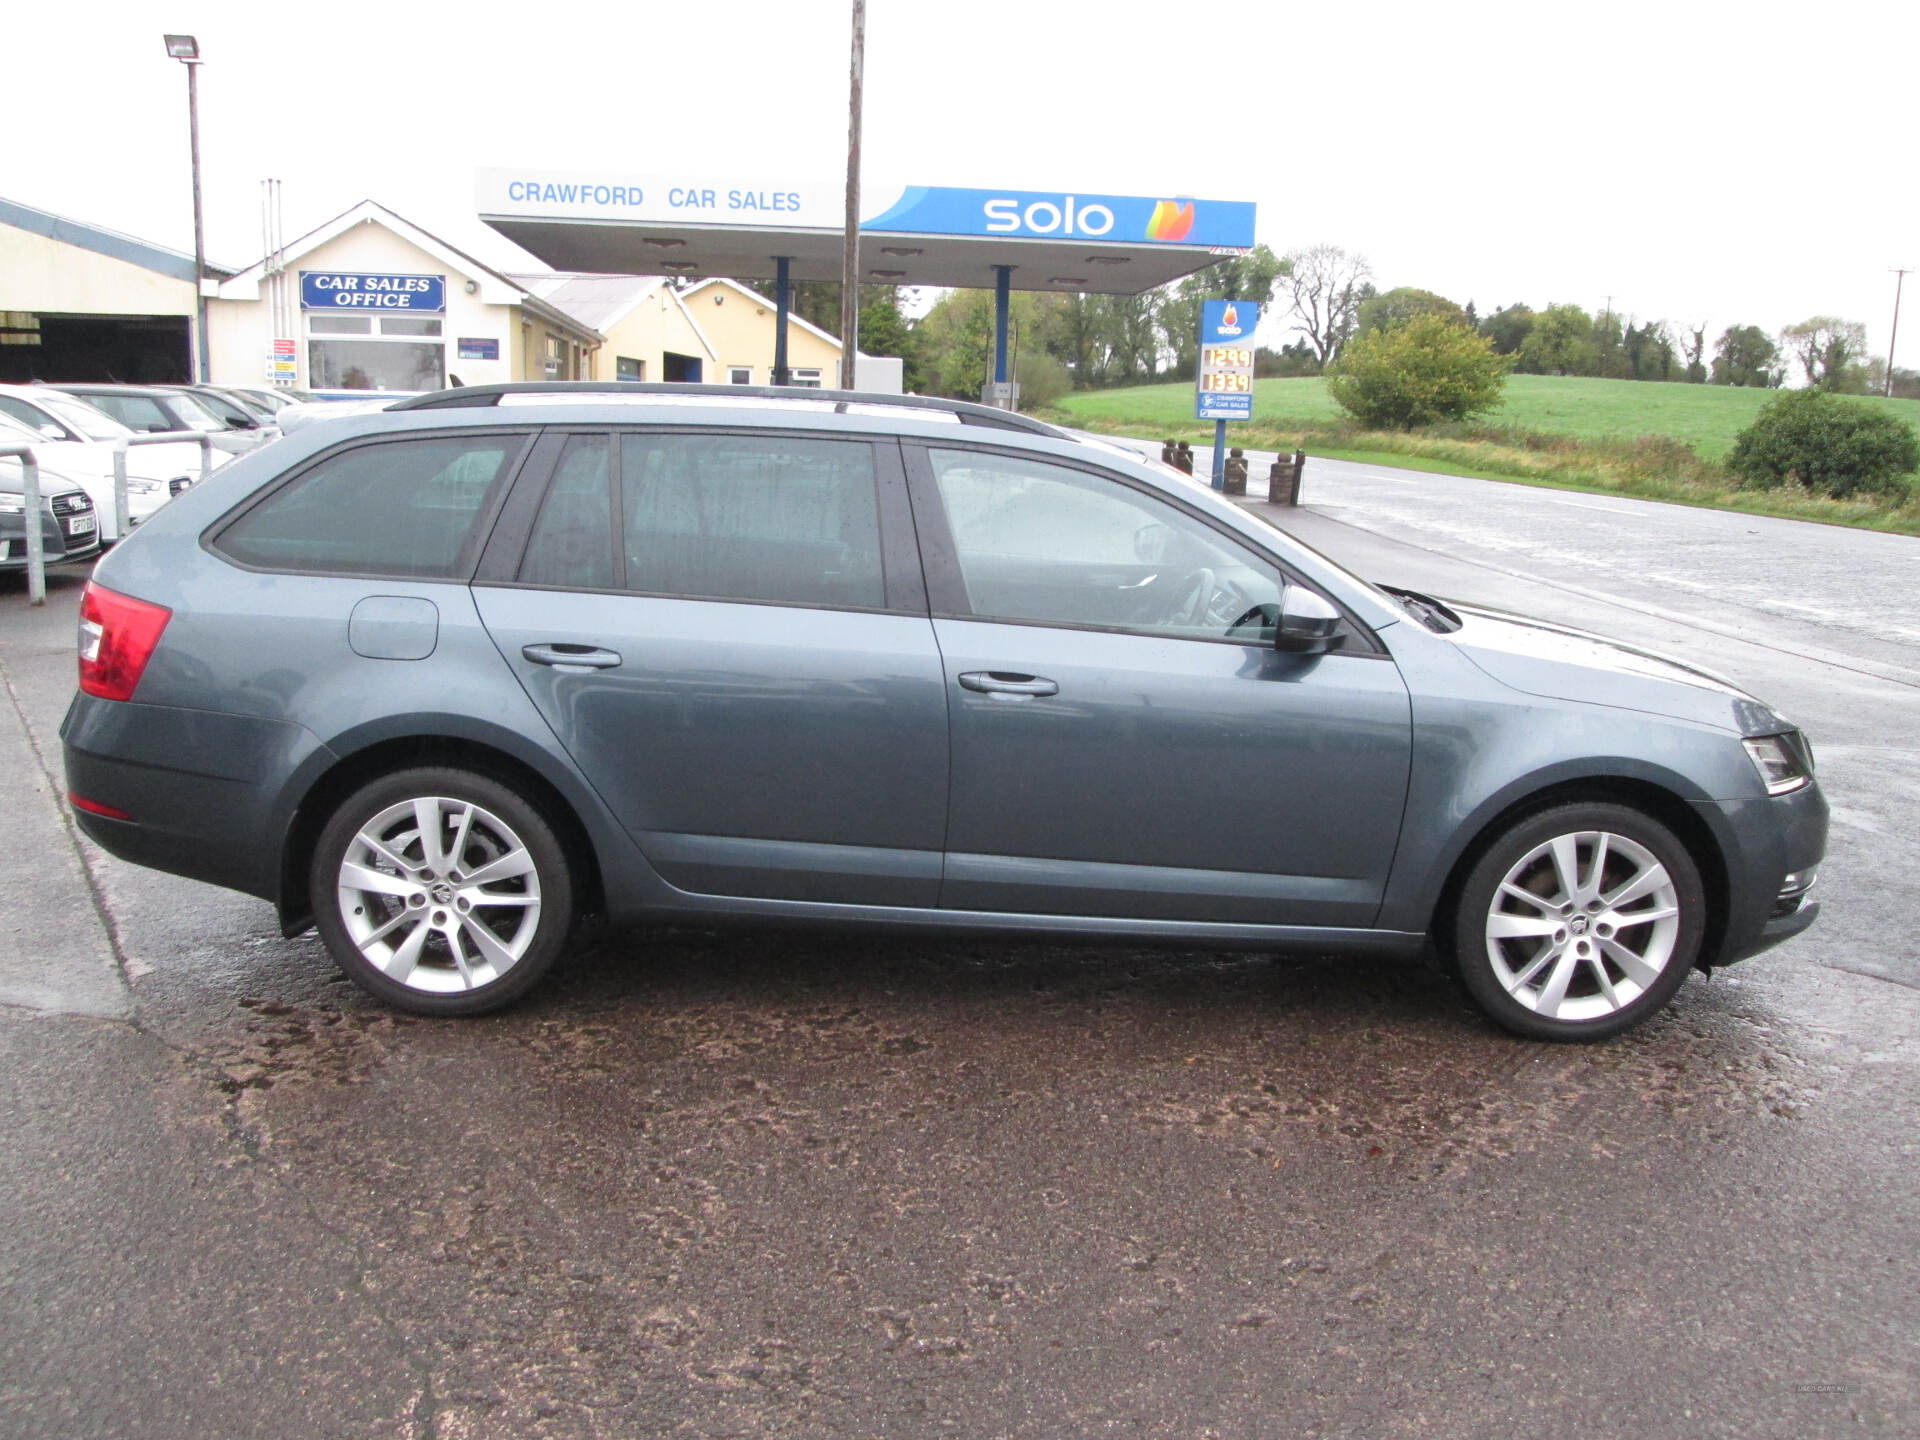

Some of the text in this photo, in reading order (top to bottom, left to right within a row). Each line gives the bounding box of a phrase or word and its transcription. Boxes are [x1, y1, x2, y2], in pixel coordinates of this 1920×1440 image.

[508, 181, 801, 212] CRAWFORD CAR SALES
[315, 276, 430, 292] CAR SALES
[335, 292, 411, 307] OFFICE
